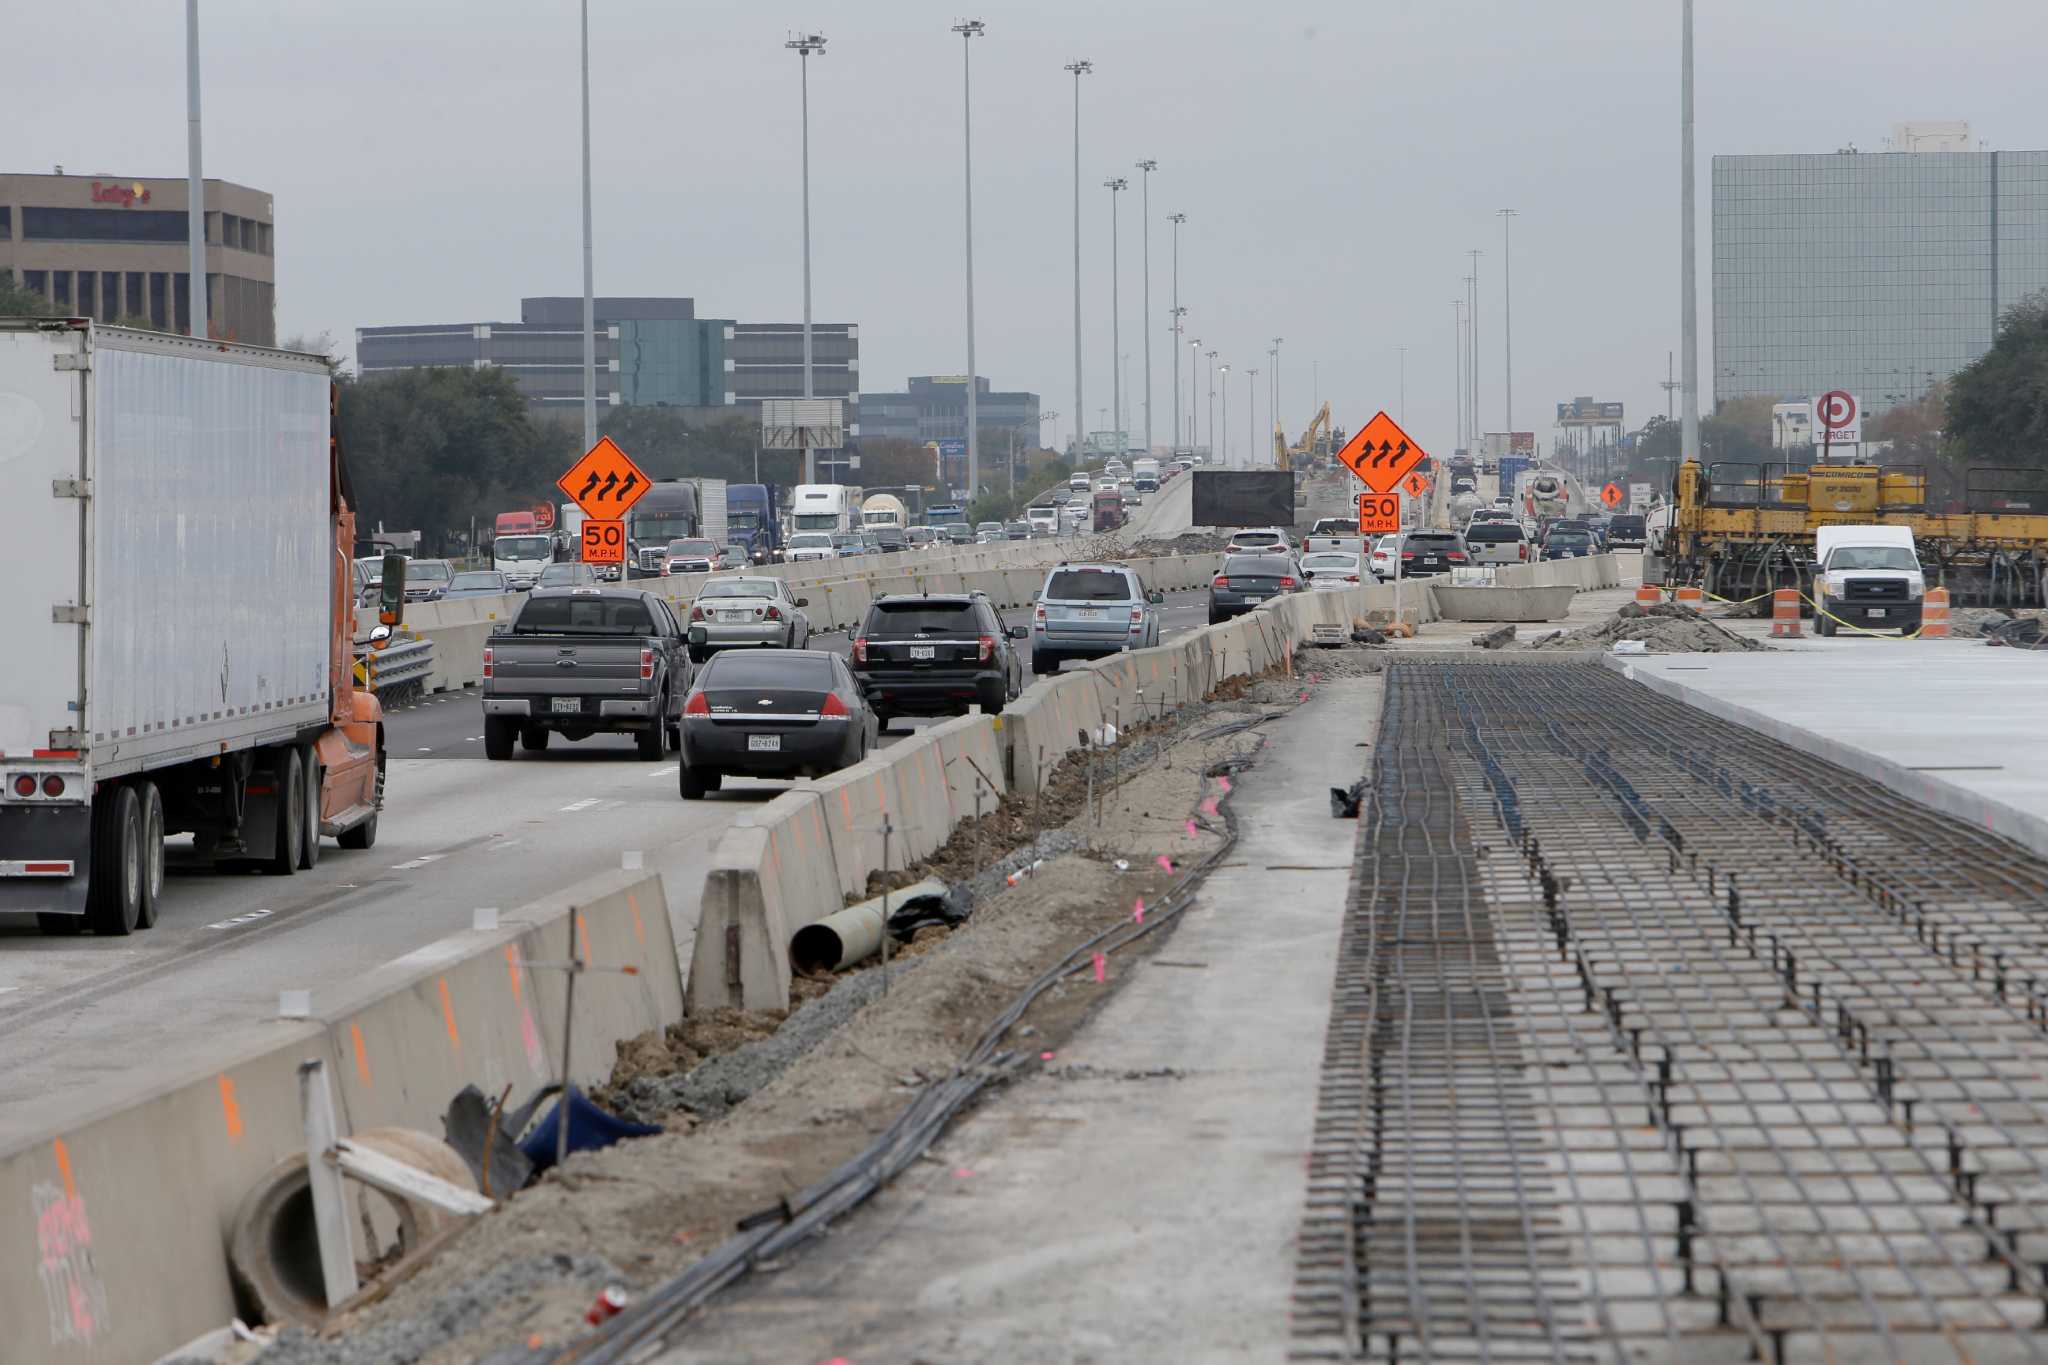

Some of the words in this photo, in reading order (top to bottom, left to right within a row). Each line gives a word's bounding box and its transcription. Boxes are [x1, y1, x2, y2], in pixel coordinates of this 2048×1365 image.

[1817, 430, 1857, 441] TRGET
[1363, 499, 1395, 517] 50
[586, 526, 620, 545] 50
